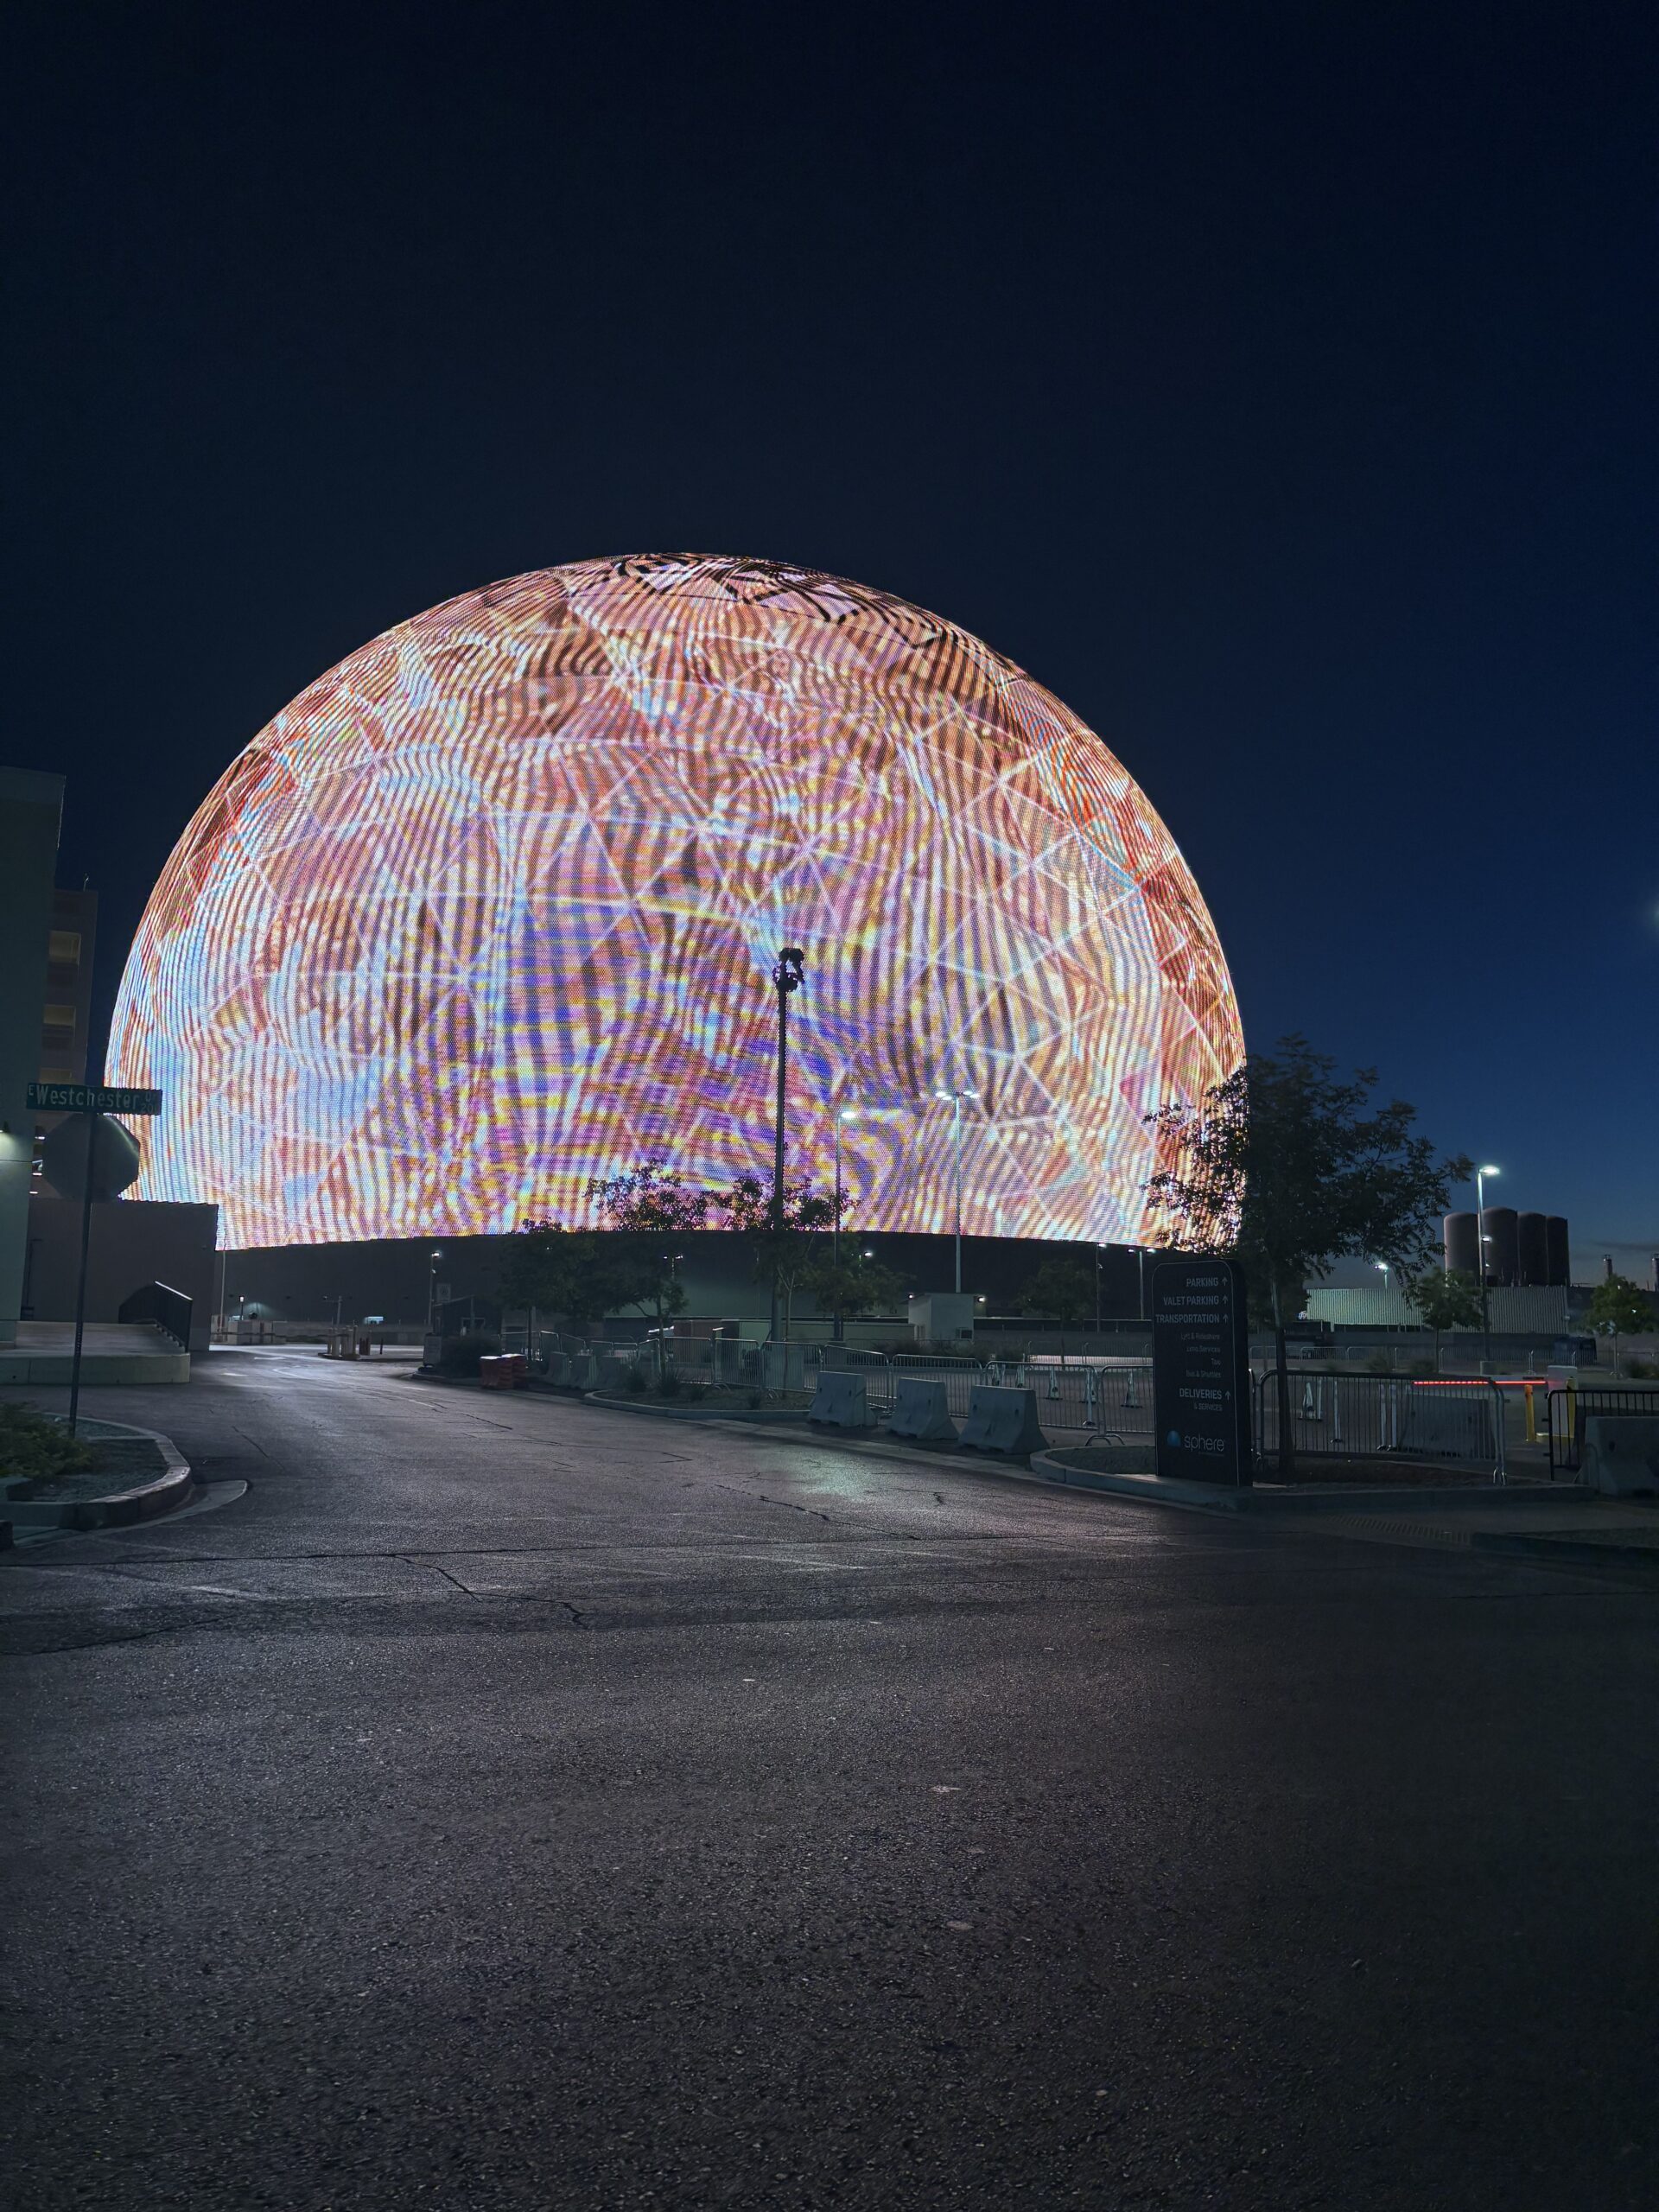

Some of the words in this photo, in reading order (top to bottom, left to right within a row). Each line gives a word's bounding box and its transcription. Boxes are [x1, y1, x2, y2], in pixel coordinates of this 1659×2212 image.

[29, 1085, 35, 1096] E
[36, 1085, 140, 1110] Westchester
[1186, 1278, 1219, 1287] PARKING
[1163, 1296, 1185, 1306] VALET
[1186, 1295, 1219, 1306] PARKING
[1155, 1313, 1220, 1324] TRANSPORTATION
[1179, 1389, 1223, 1400] DELIVERIES
[1185, 1433, 1224, 1452] sphere
